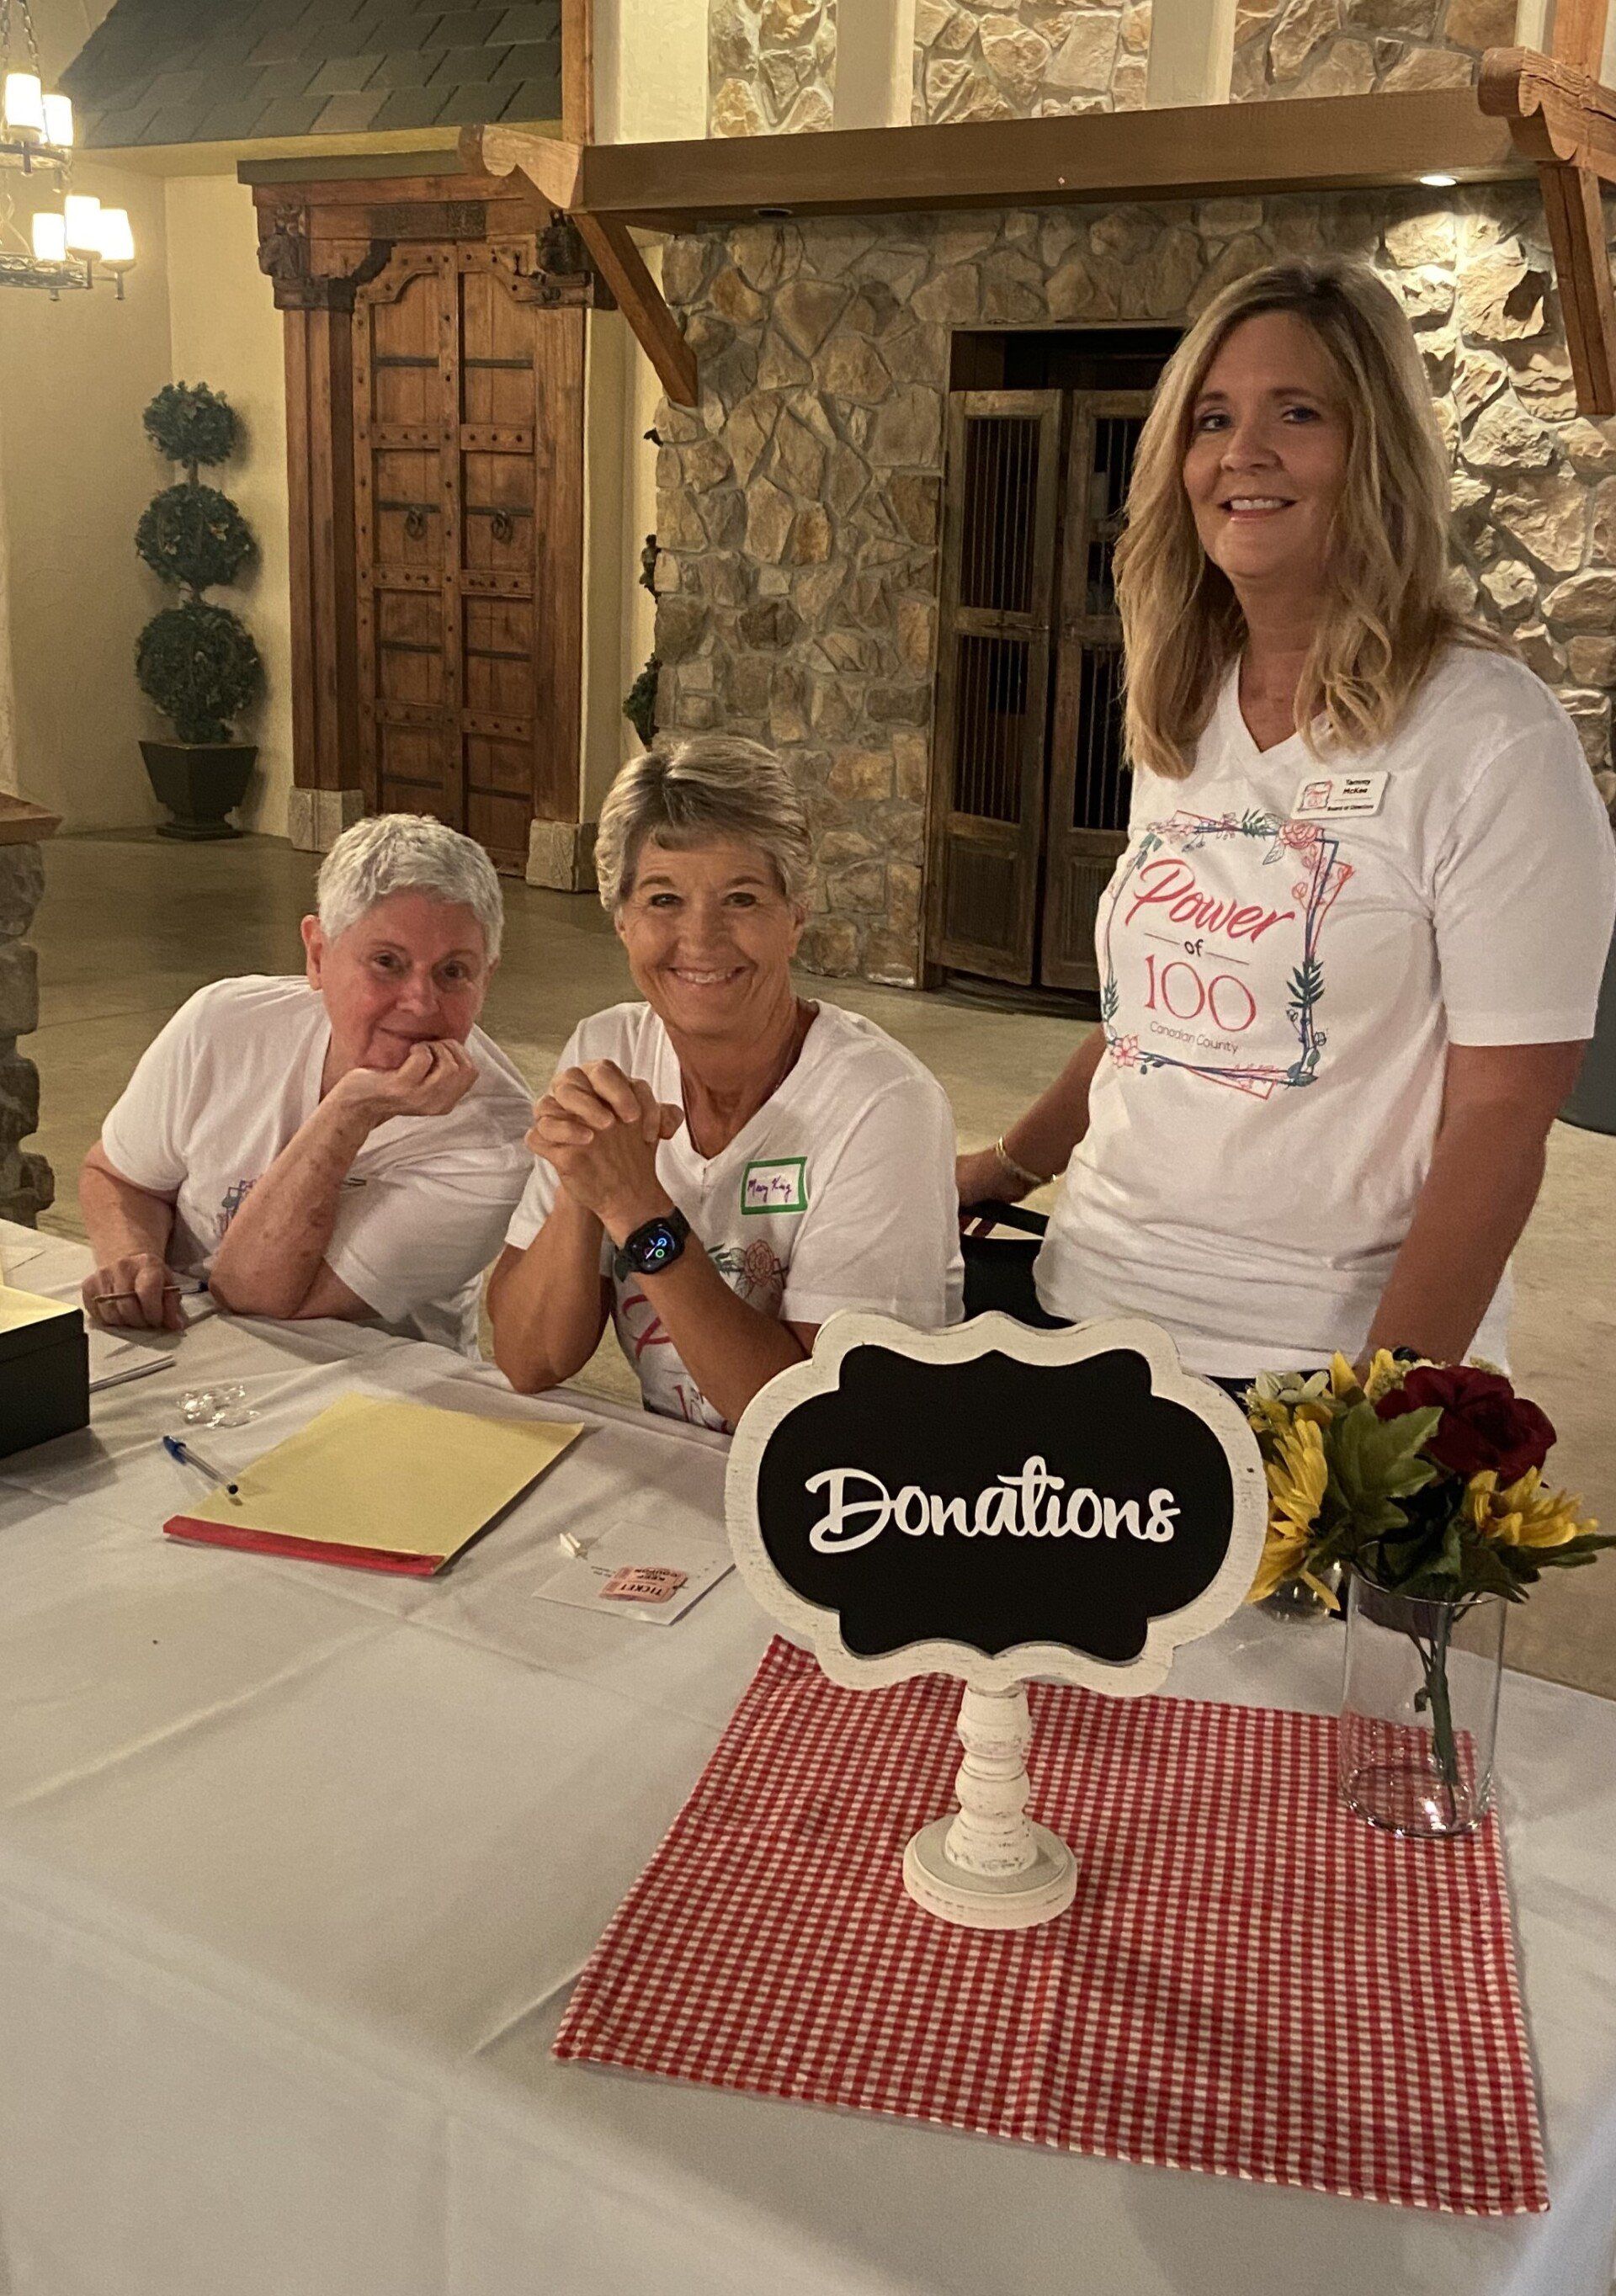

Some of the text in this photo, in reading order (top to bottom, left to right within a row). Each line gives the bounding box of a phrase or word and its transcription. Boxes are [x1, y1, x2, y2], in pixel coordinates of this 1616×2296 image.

[1125, 858, 1295, 943] Power
[1184, 939, 1204, 957] of
[1145, 954, 1257, 1032] 100
[1150, 1021, 1238, 1055] Canadian County
[805, 1455, 1181, 1554] Donations
